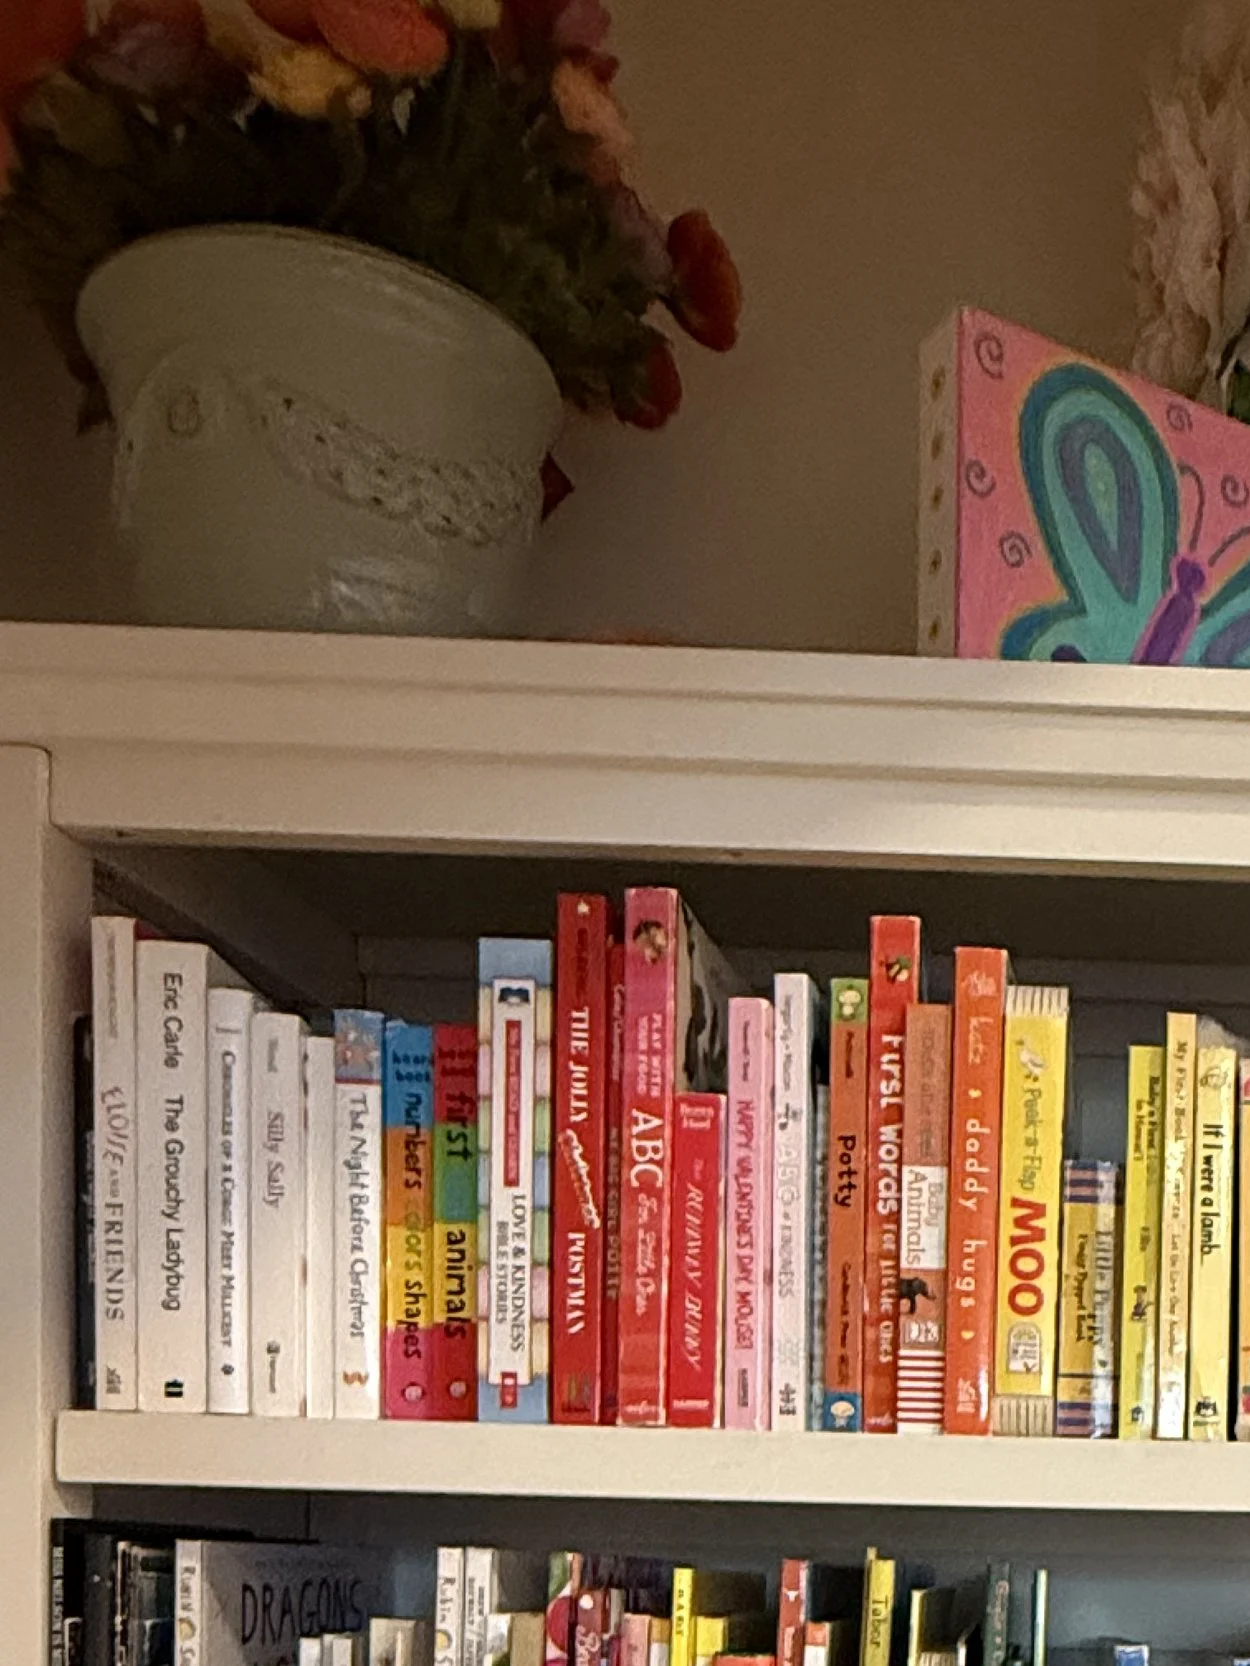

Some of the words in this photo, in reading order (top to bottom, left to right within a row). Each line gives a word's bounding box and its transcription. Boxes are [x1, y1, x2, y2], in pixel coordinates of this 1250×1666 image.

[163, 973, 183, 1010] Eric
[163, 1017, 183, 1069] Carle
[569, 1008, 588, 1054] THE
[568, 1061, 589, 1125] JOLLY
[878, 1035, 899, 1109] First
[100, 1087, 127, 1166] ELOISE
[166, 1096, 183, 1132] The
[263, 1112, 285, 1152] Silly
[348, 1094, 367, 1132] The
[404, 1094, 424, 1189] numbers
[444, 1091, 473, 1159] first
[737, 1100, 754, 1151] HAPPY
[1203, 1124, 1224, 1140] If
[162, 1139, 183, 1220] Grouchy
[342, 1139, 367, 1188] Night
[630, 1109, 664, 1188] ABC
[835, 1135, 857, 1207] Potty
[877, 1125, 901, 1214] Words
[959, 1118, 992, 1211] daddy
[1201, 1155, 1219, 1191] were
[264, 1161, 285, 1208] Sally
[924, 1183, 944, 1228] Baby
[1201, 1197, 1216, 1207] a
[348, 1194, 367, 1254] Before
[510, 1194, 526, 1242] LOVE
[904, 1169, 927, 1266] Animals
[105, 1202, 125, 1321] FRIENDS
[162, 1228, 184, 1310] Ladybug
[444, 1231, 471, 1339] animals
[511, 1247, 524, 1259] &
[567, 1232, 586, 1335] POSTMAN
[735, 1254, 754, 1286] DAY
[957, 1238, 991, 1308] hugs
[1009, 1197, 1047, 1316] MOO
[1091, 1230, 1112, 1281] Little
[349, 1259, 368, 1338] Christmas
[397, 1279, 425, 1358] shapes
[495, 1264, 508, 1324] STORIES
[510, 1264, 525, 1352] KINDNESS
[242, 1579, 365, 1646] DRAGONS
[867, 1597, 886, 1646] Tabor
